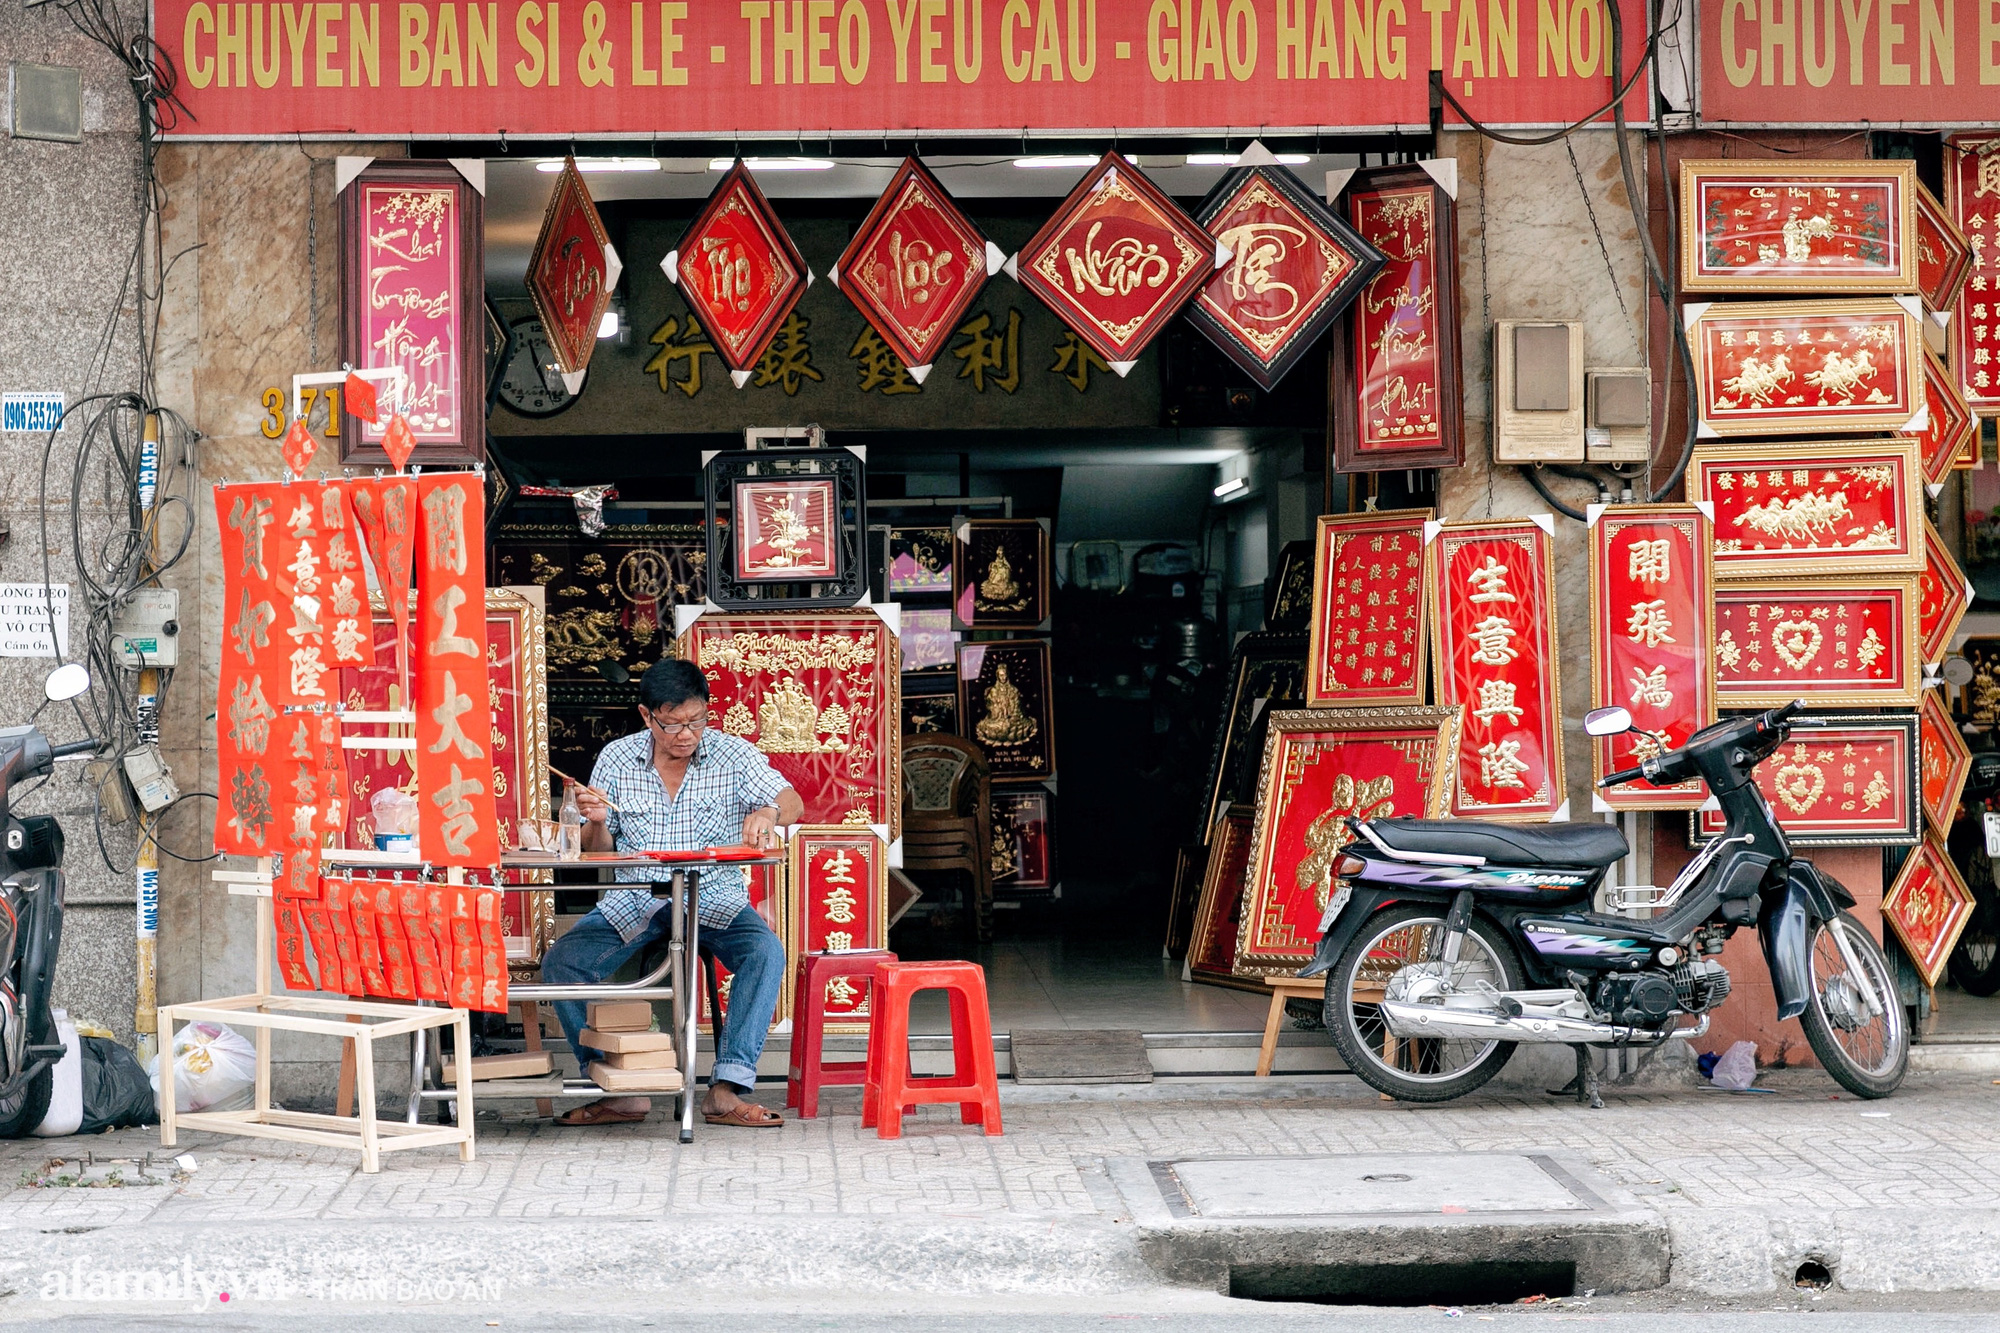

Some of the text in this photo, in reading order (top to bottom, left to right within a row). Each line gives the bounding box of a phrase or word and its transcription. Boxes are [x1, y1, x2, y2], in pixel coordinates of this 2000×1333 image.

[578, 0, 614, 87] &
[740, 0, 870, 85] THEO
[1147, 0, 1258, 82] GIAO
[5, 401, 26, 430] 0906
[28, 401, 45, 430] 255
[261, 387, 340, 438] 371
[15, 605, 62, 616] TRANG
[1746, 604, 1763, 673] 百年好合
[422, 483, 485, 857] 開工大吉
[1467, 555, 1531, 789] 生意興隆
[1537, 926, 1567, 934] HONDA
